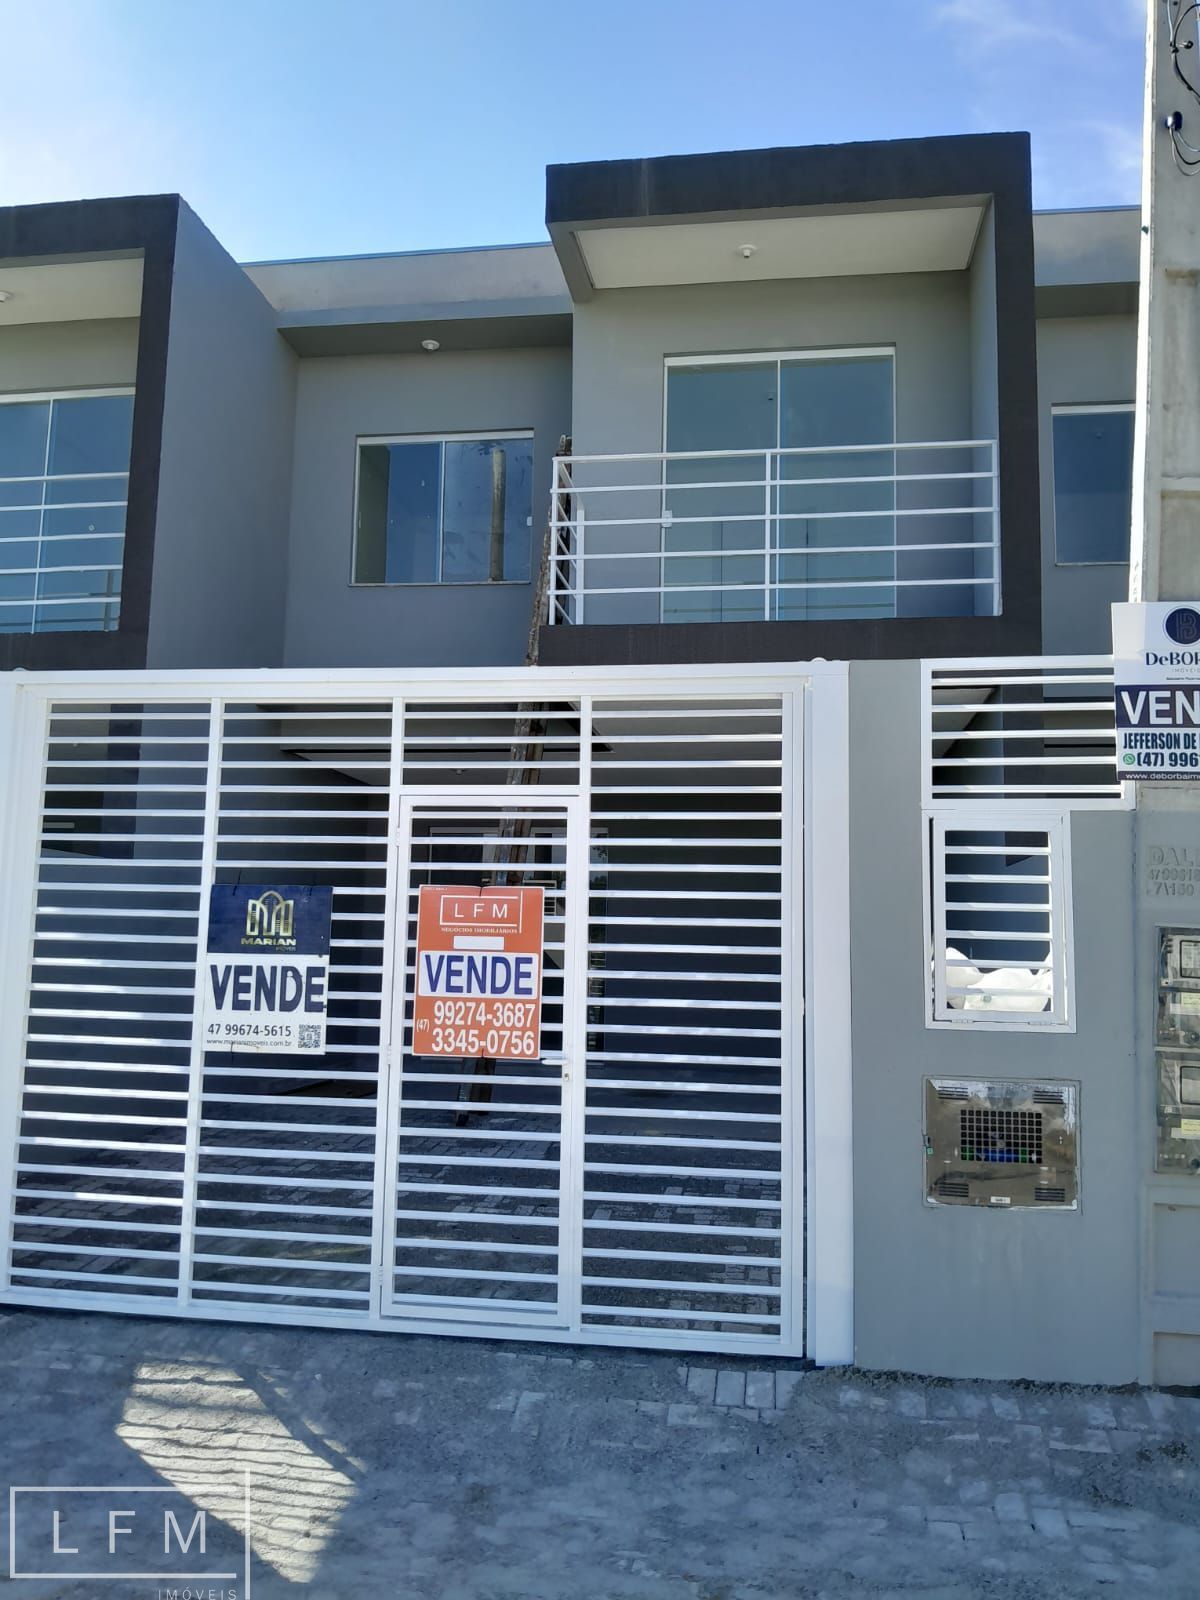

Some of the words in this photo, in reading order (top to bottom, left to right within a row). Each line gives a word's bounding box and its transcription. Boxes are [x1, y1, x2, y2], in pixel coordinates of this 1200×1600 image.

[1120, 690, 1200, 725] VEN
[1123, 732, 1181, 750] JEFFERSON
[1184, 732, 1197, 750] DE
[1137, 751, 1165, 767] (47)
[1168, 752, 1200, 768] 996
[241, 938, 297, 946] MARIAN
[425, 954, 533, 995] VENDE
[210, 964, 326, 1013] VENDE
[416, 1018, 430, 1032] (47)
[434, 1001, 536, 1028] 99274-3687
[208, 1023, 221, 1035] 47
[225, 1023, 292, 1037] 99674-5615
[431, 1028, 535, 1055] 3345-0756
